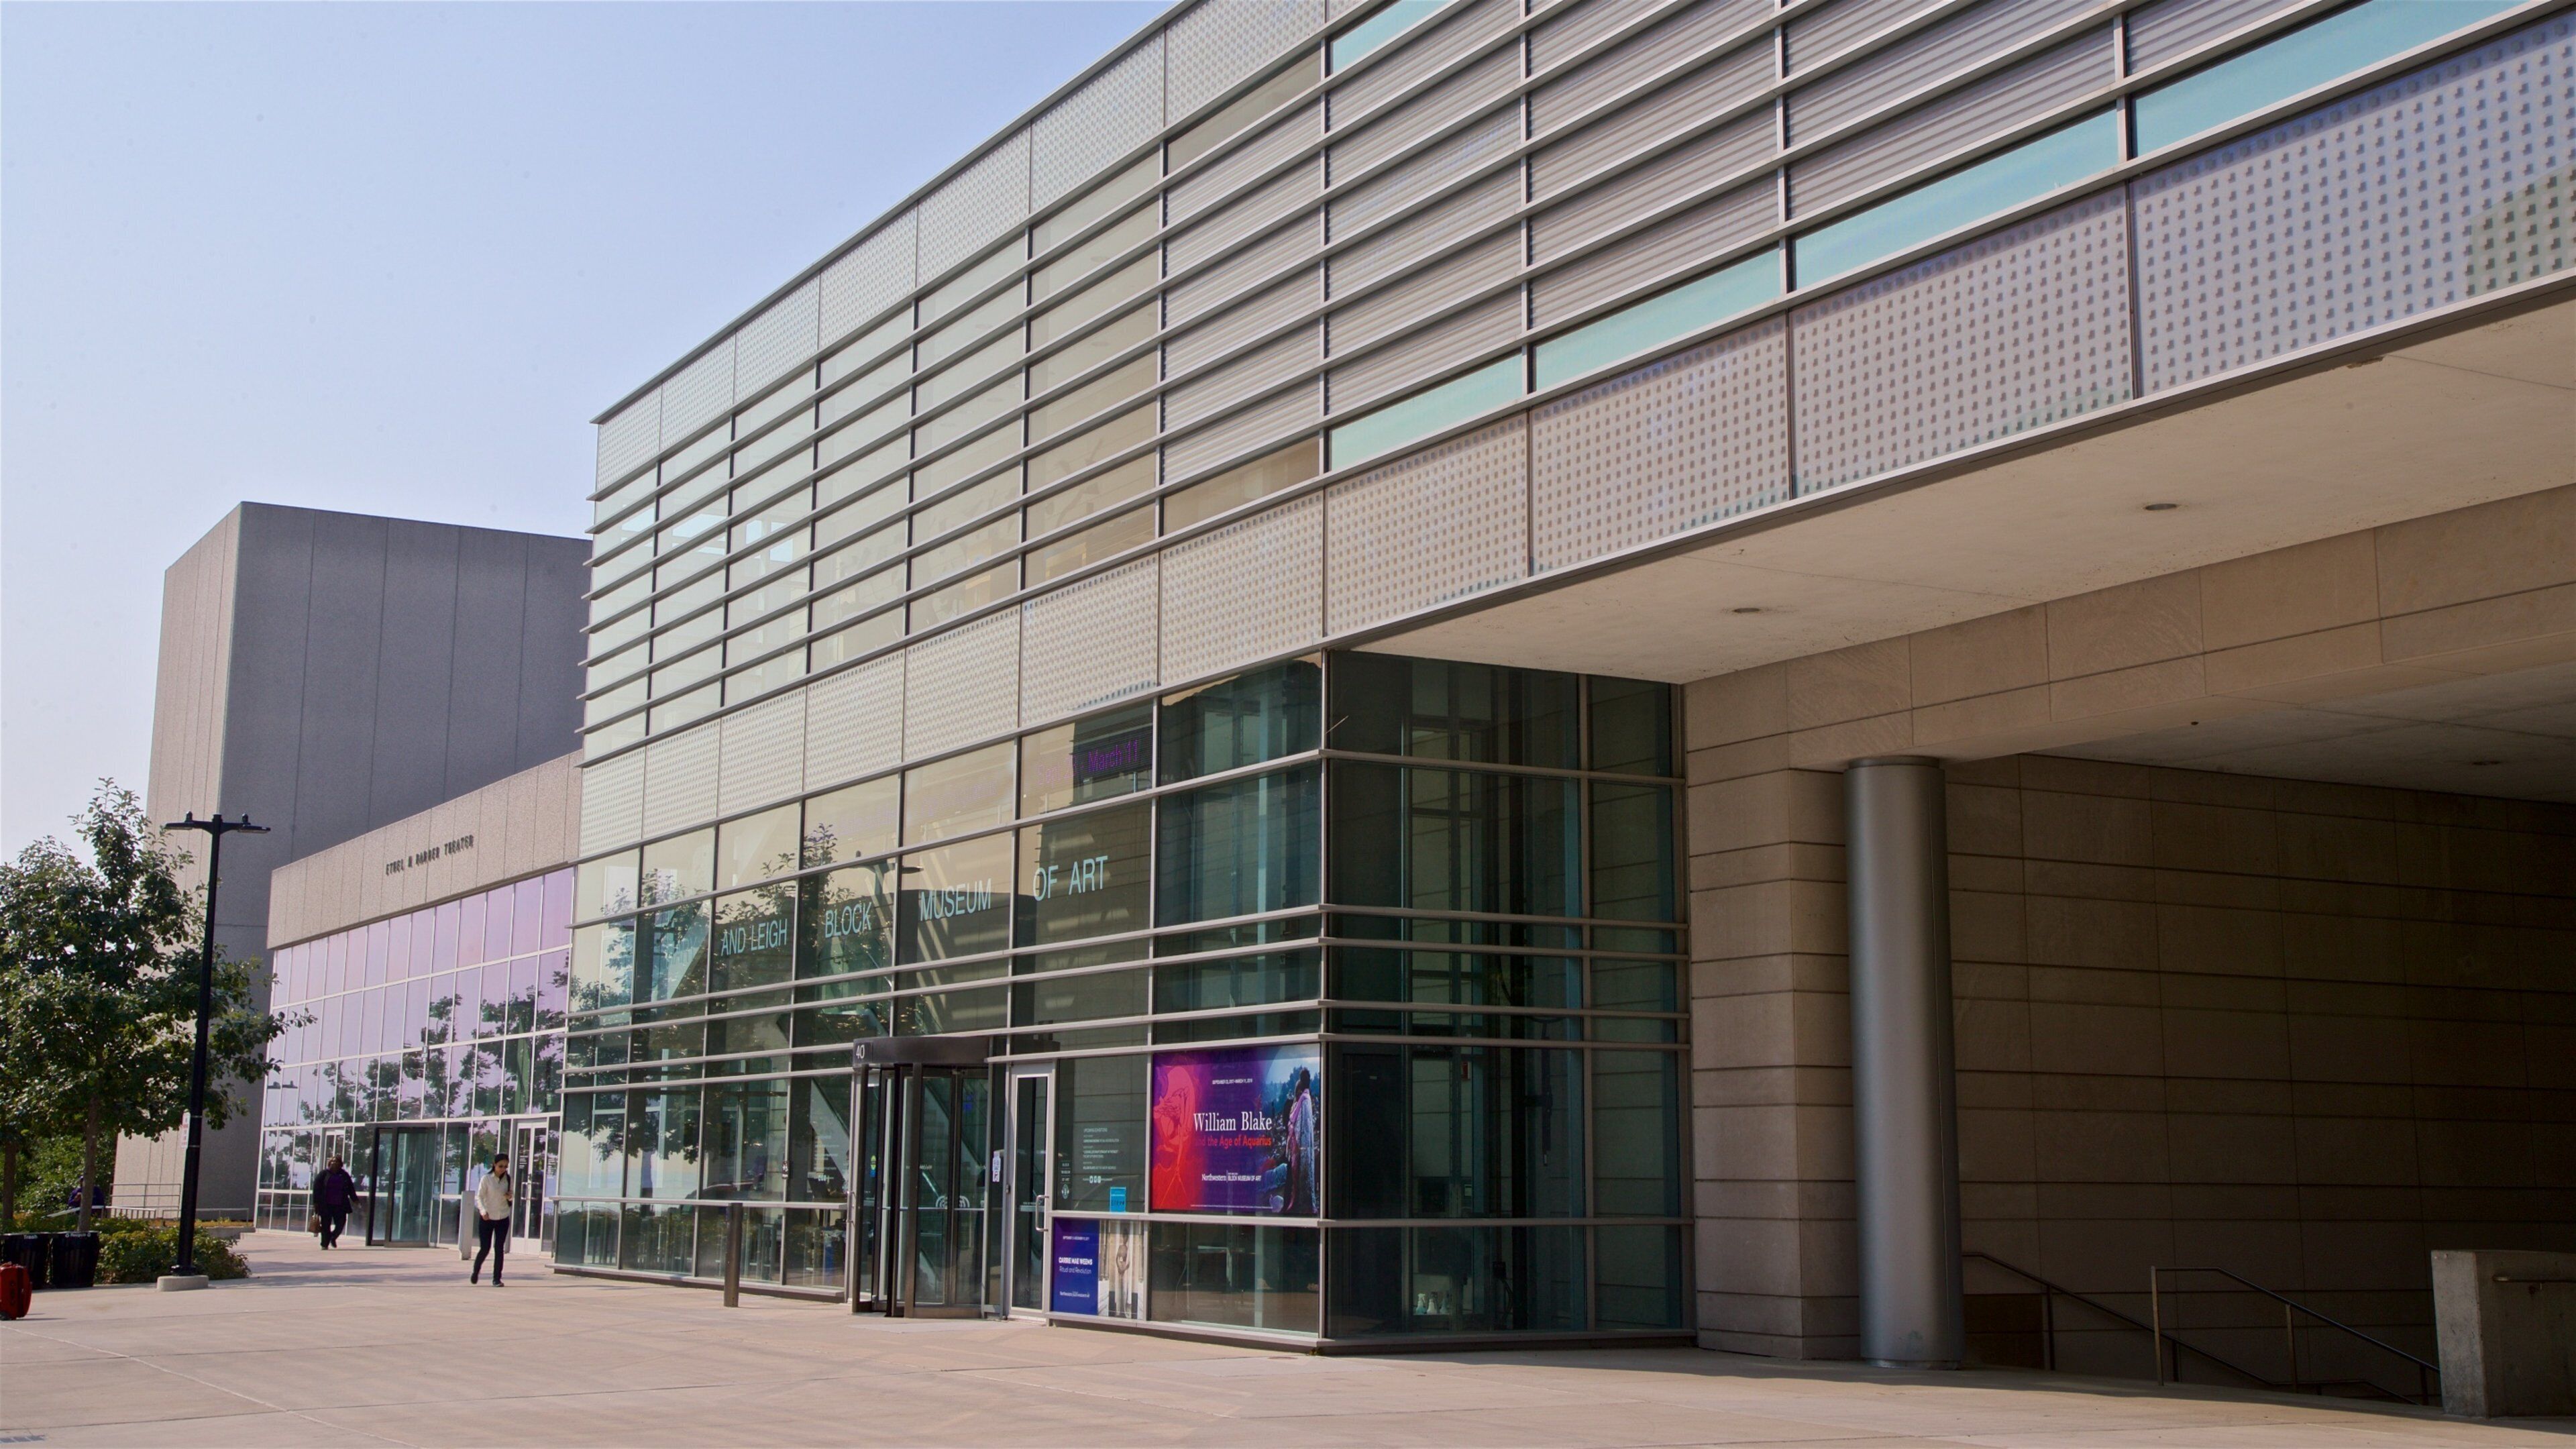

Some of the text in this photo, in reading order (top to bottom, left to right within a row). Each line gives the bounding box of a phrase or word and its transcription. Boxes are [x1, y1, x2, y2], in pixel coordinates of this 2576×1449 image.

[1088, 745, 1122, 773] March
[1126, 739, 1138, 763] 11
[386, 859, 405, 876] ETHEL
[416, 847, 439, 866] BARBER
[444, 835, 474, 856] THEATER
[720, 926, 746, 957] AND
[751, 918, 788, 951] LEIGH
[825, 902, 872, 938] BLOCK
[920, 878, 991, 921] MUSEUM
[1033, 865, 1059, 901] OF
[1069, 855, 1108, 895] ART
[856, 1044, 865, 1059] 40
[1193, 1111, 1272, 1132] William Blake
[1208, 1135, 1218, 1146] the
[1220, 1134, 1232, 1149] Age
[1234, 1134, 1242, 1146] of
[1242, 1134, 1272, 1148] Aquarius
